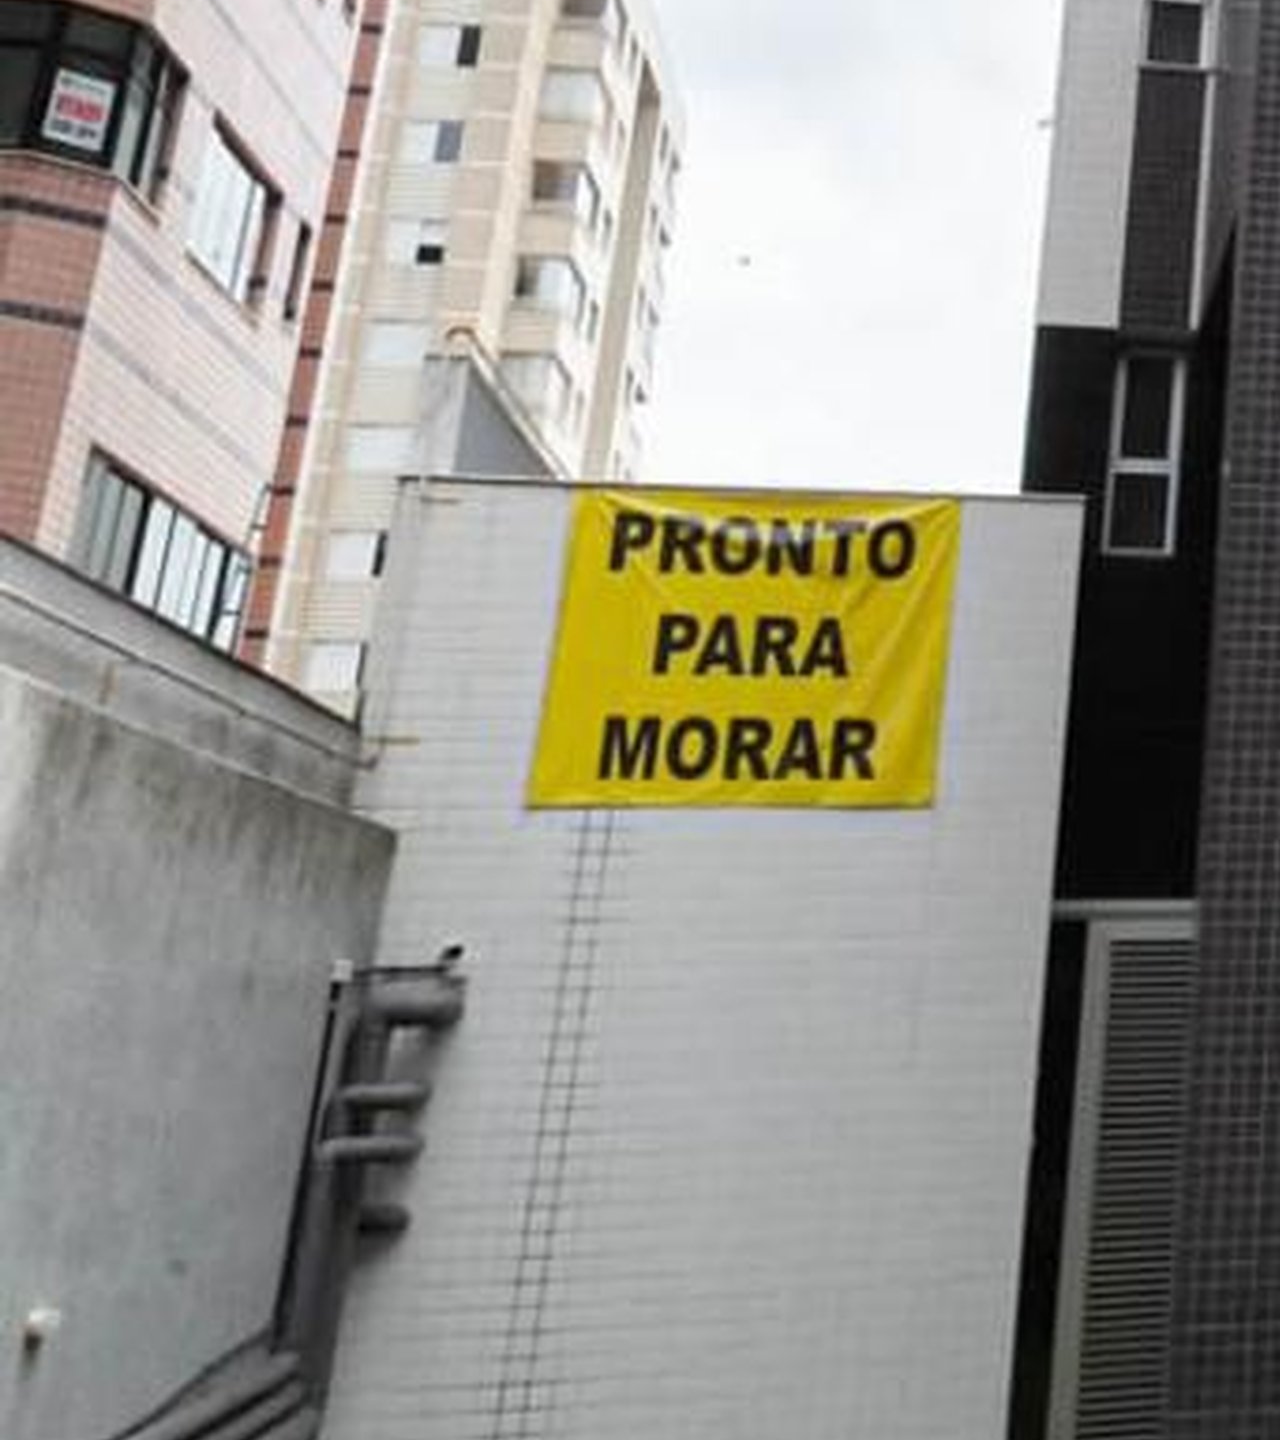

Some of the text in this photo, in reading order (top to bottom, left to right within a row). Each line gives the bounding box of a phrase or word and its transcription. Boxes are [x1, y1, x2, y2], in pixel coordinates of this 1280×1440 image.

[609, 511, 917, 580] PRONTO
[653, 614, 849, 678] PARA
[598, 716, 877, 781] MORAR
